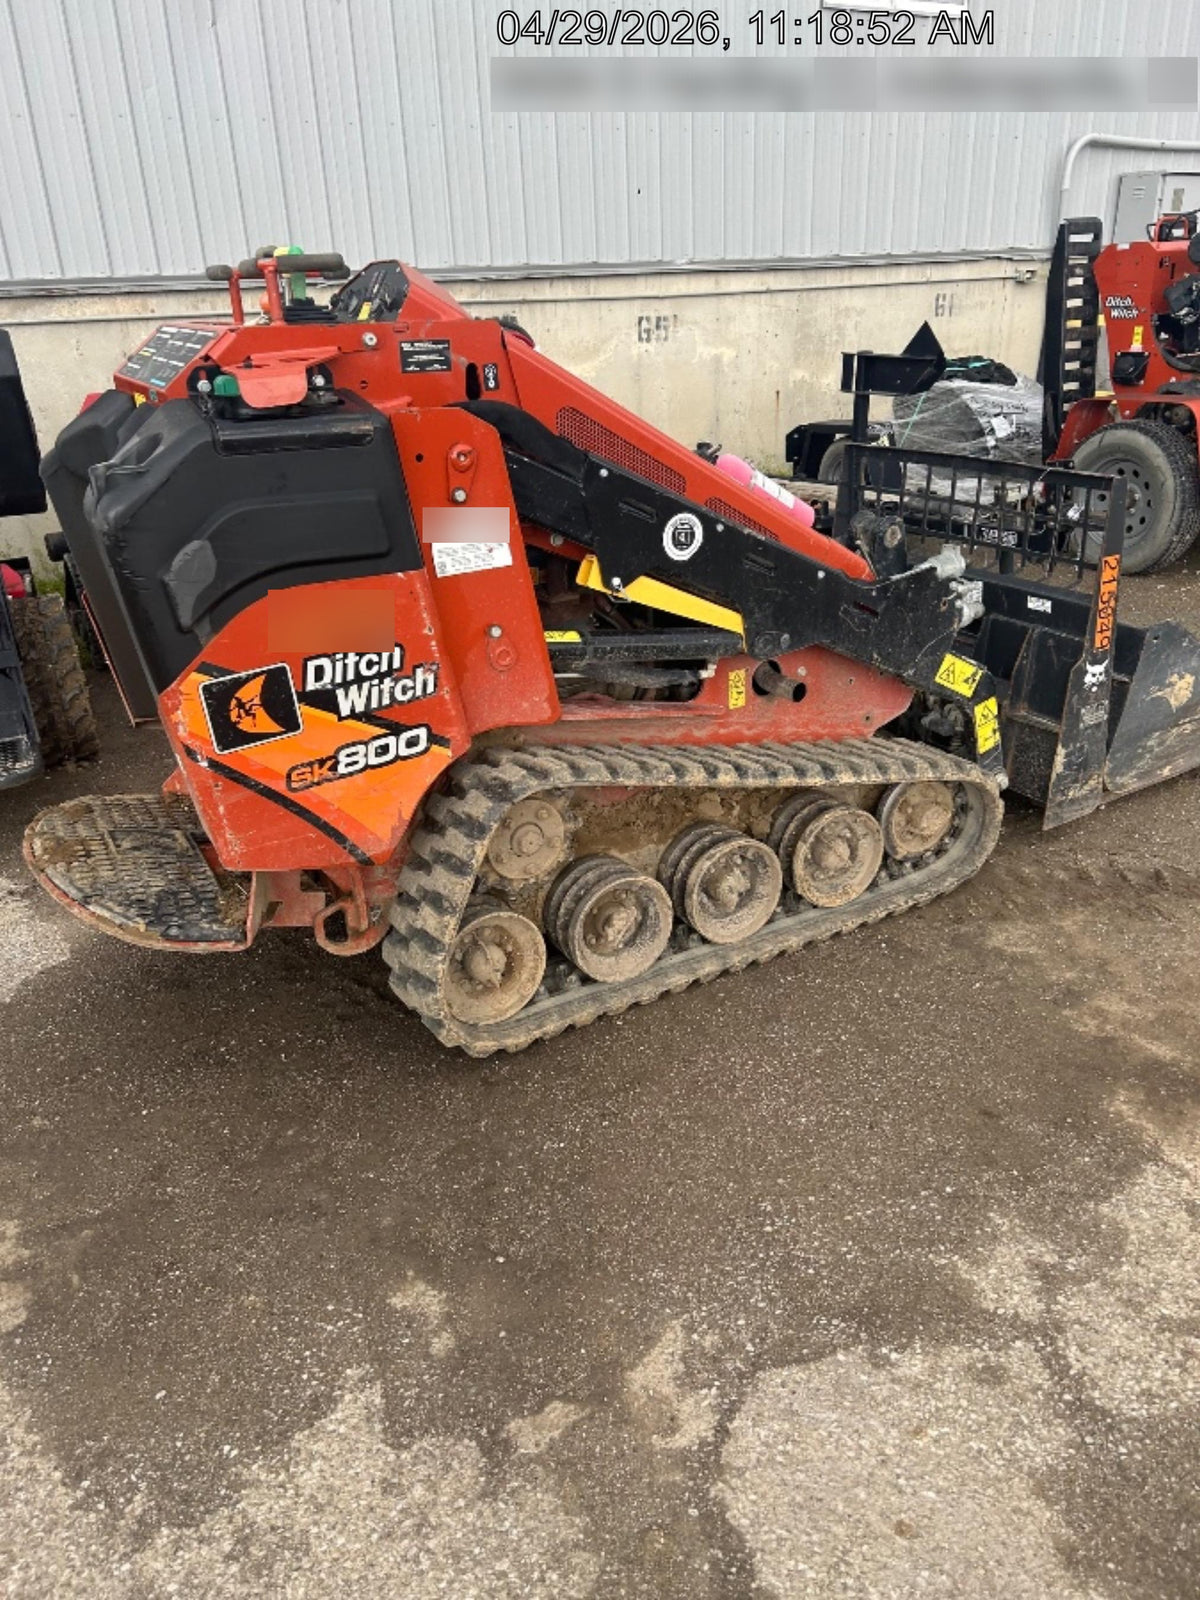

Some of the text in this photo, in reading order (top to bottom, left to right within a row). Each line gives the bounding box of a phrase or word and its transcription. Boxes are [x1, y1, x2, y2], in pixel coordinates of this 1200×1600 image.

[304, 645, 402, 692] Ditch
[335, 665, 437, 719] Witch
[288, 725, 430, 790] SK800
